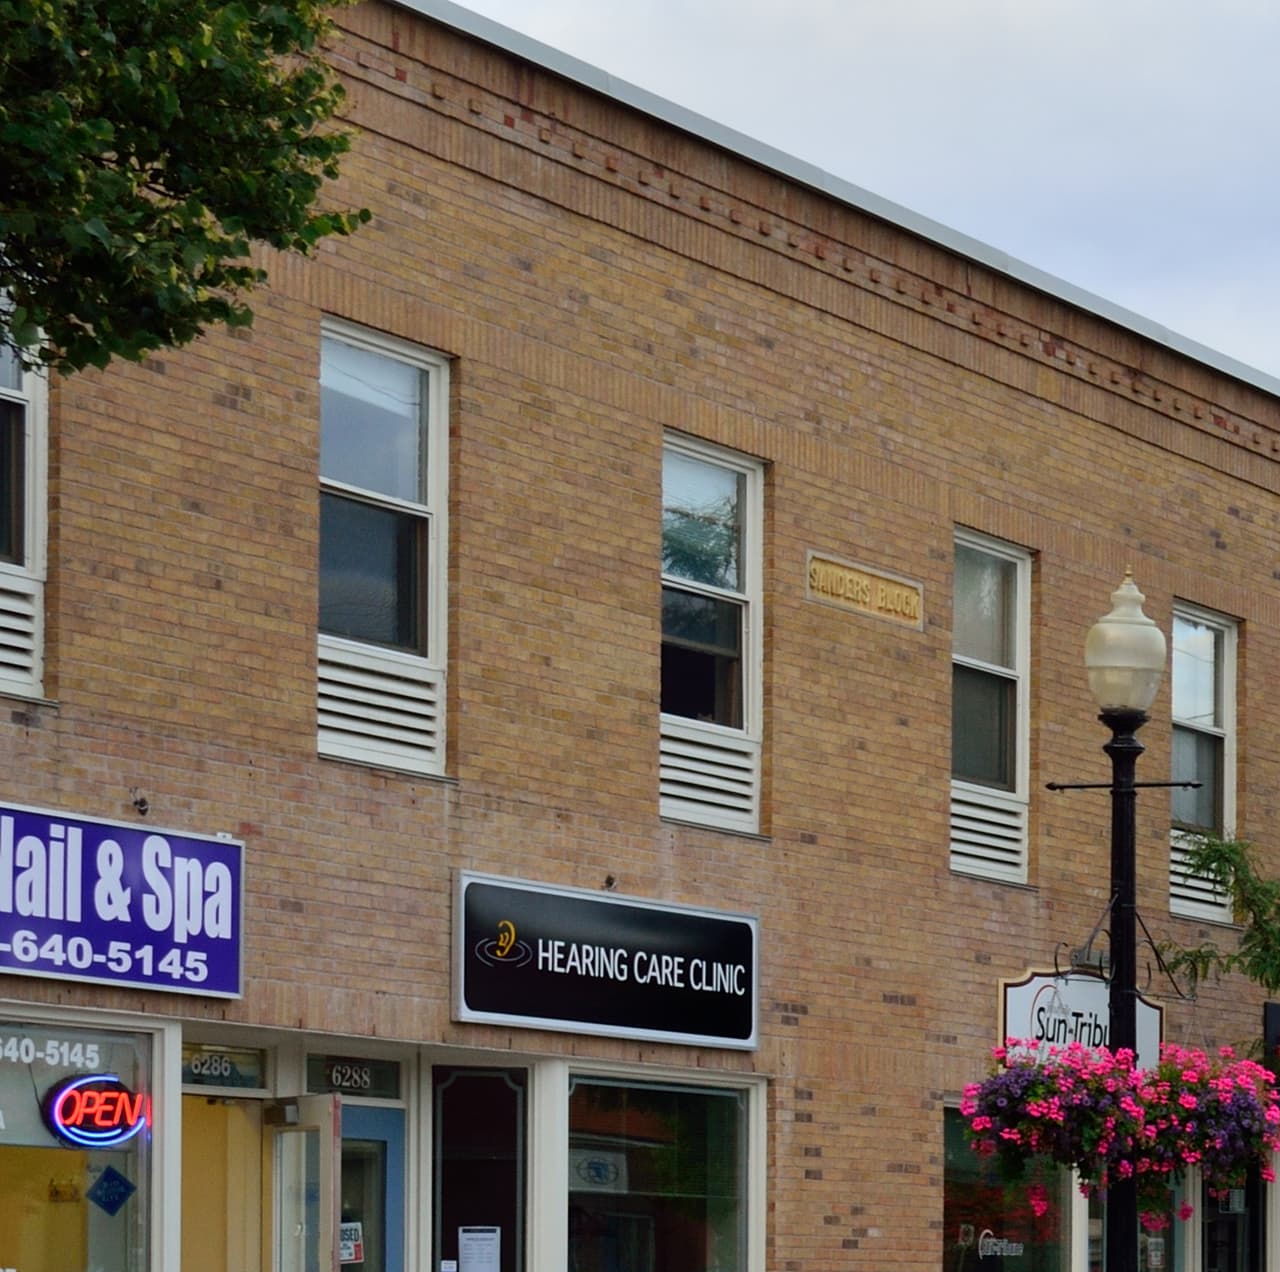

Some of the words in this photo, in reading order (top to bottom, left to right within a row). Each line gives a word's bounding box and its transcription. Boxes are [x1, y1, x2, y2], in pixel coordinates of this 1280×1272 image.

[94, 839, 131, 922] &
[142, 835, 232, 944] Spa
[538, 938, 628, 982] HEARING
[633, 951, 685, 988] CARE
[689, 958, 746, 996] CLINIC
[190, 1055, 231, 1077] 6286
[331, 1064, 371, 1089] 6288
[58, 1089, 143, 1127] OPEN
